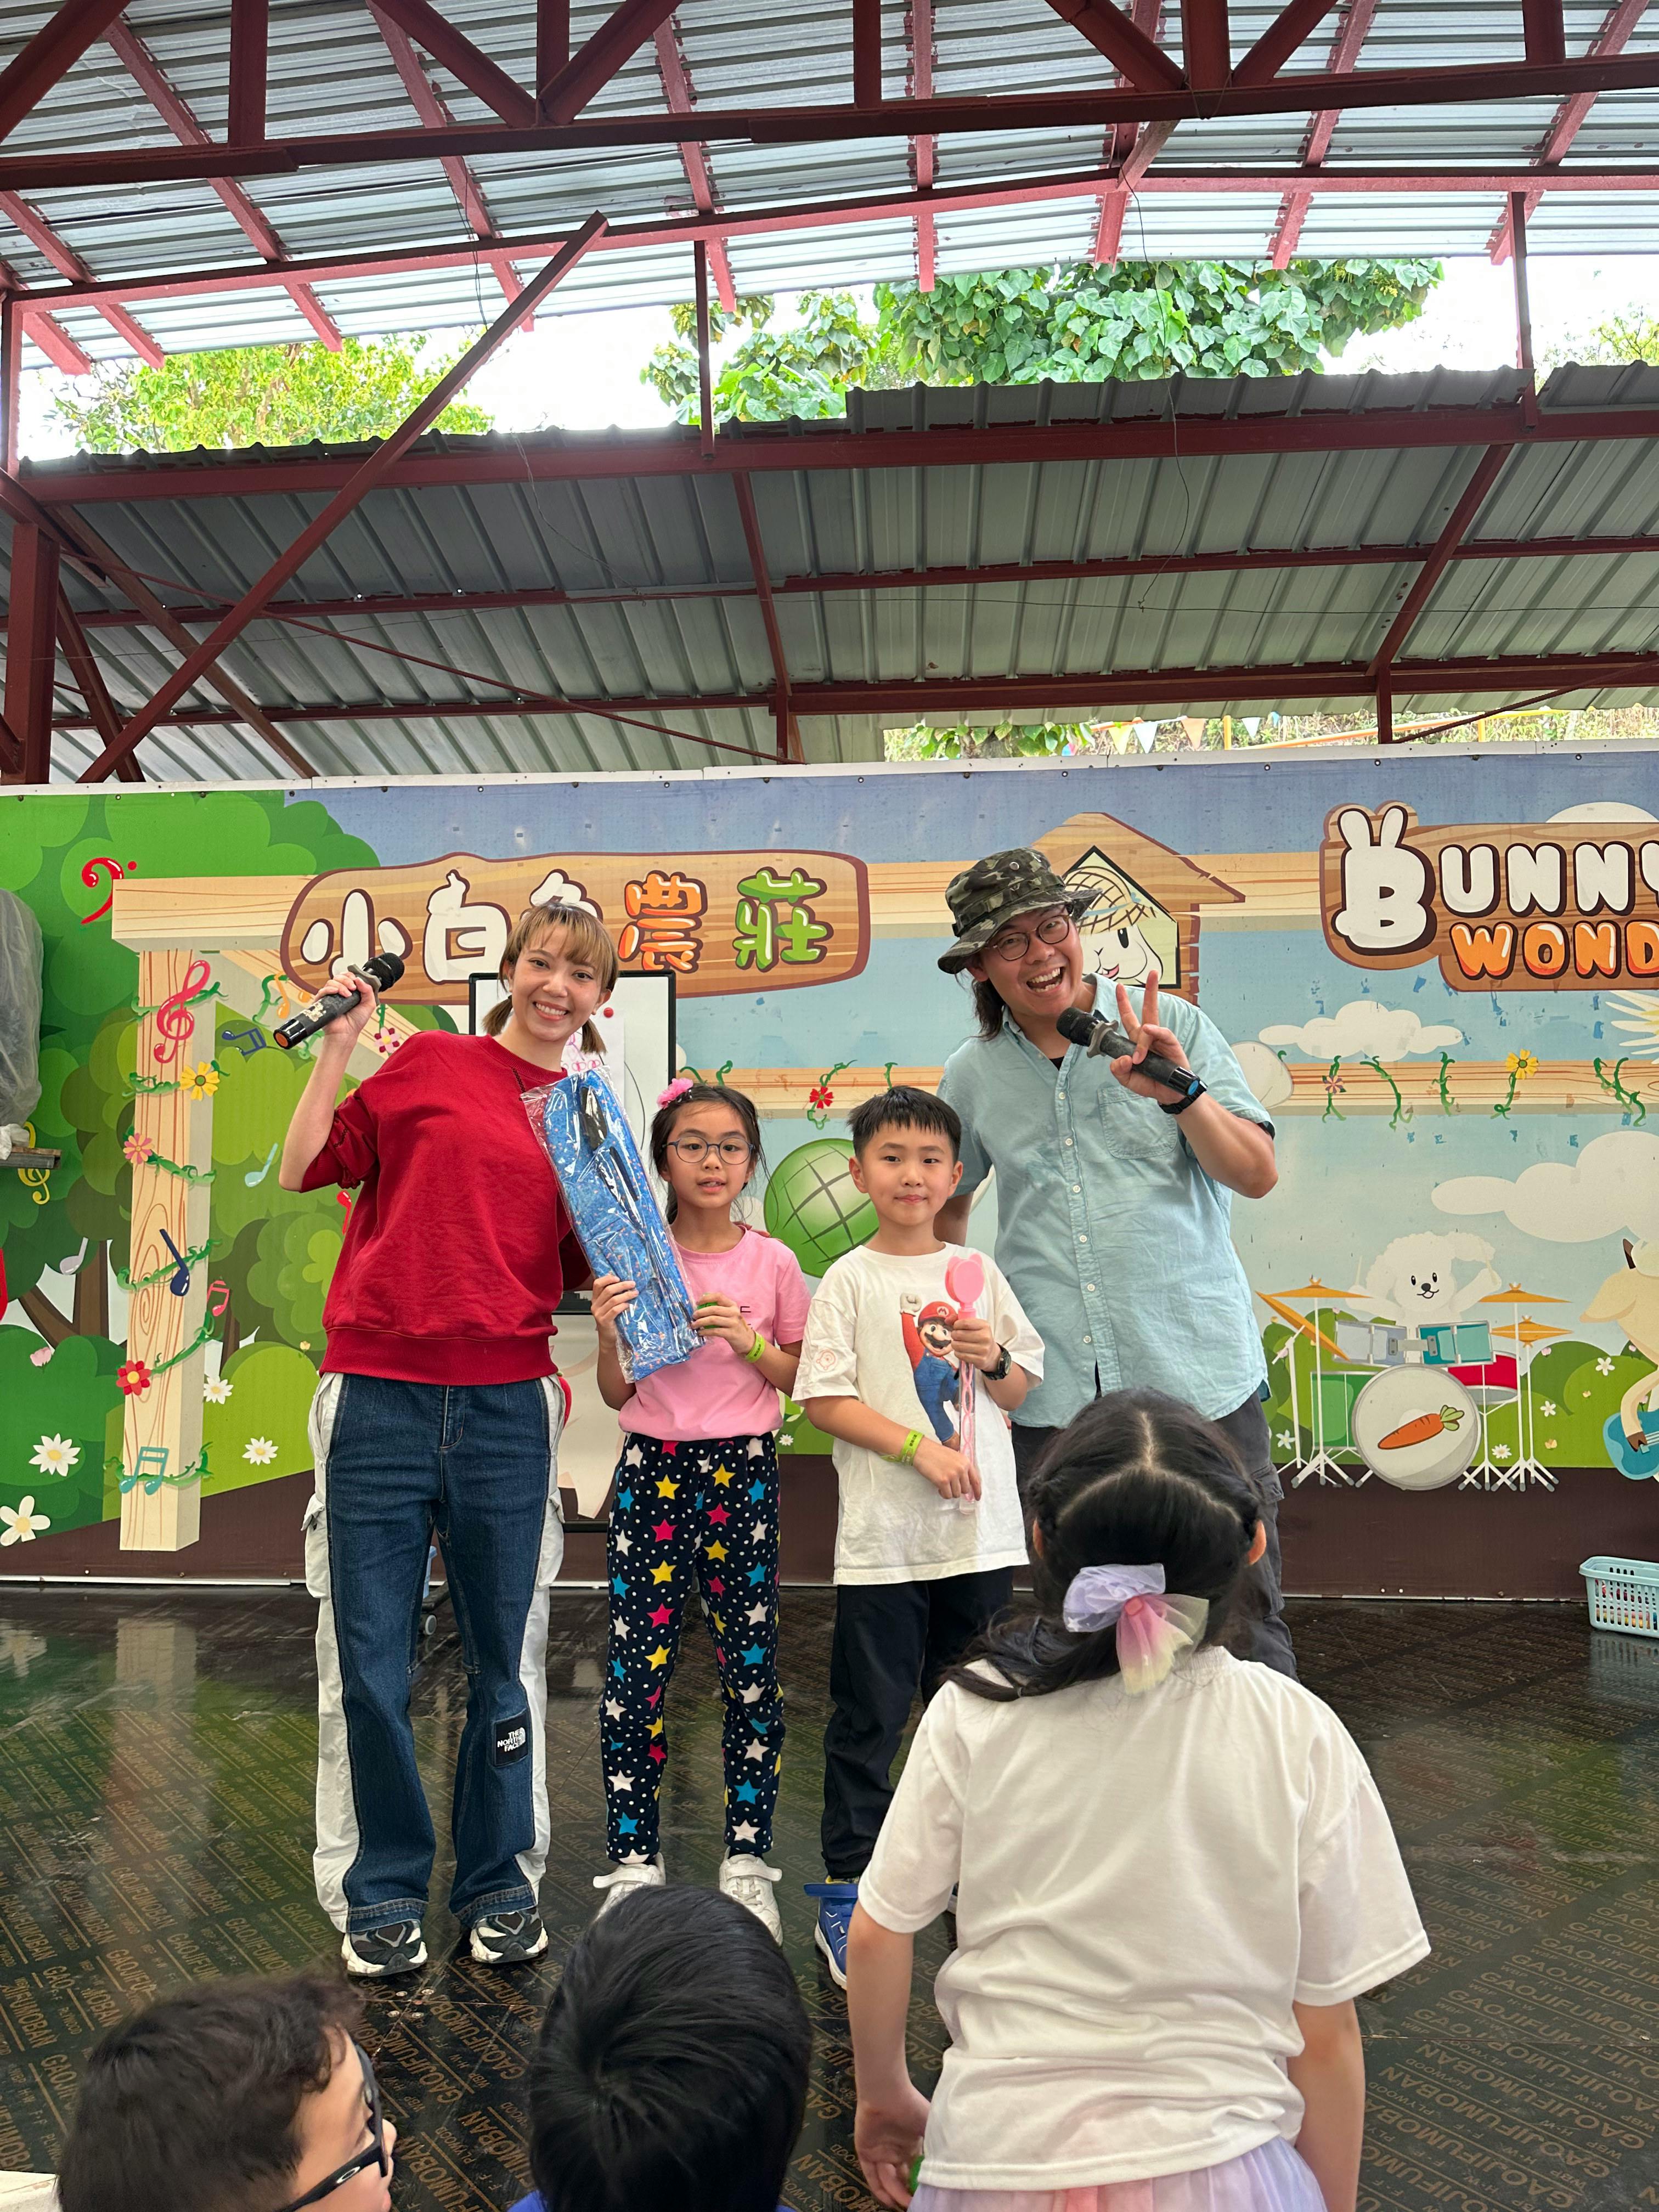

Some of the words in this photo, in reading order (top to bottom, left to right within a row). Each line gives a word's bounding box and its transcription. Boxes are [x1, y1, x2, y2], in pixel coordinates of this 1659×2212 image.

[508, 1730, 521, 1739] THE
[1378, 2066, 1610, 2178] GAOJIFUMOBAN
[1414, 2044, 1645, 2149] GAOJIFUMOBAN
